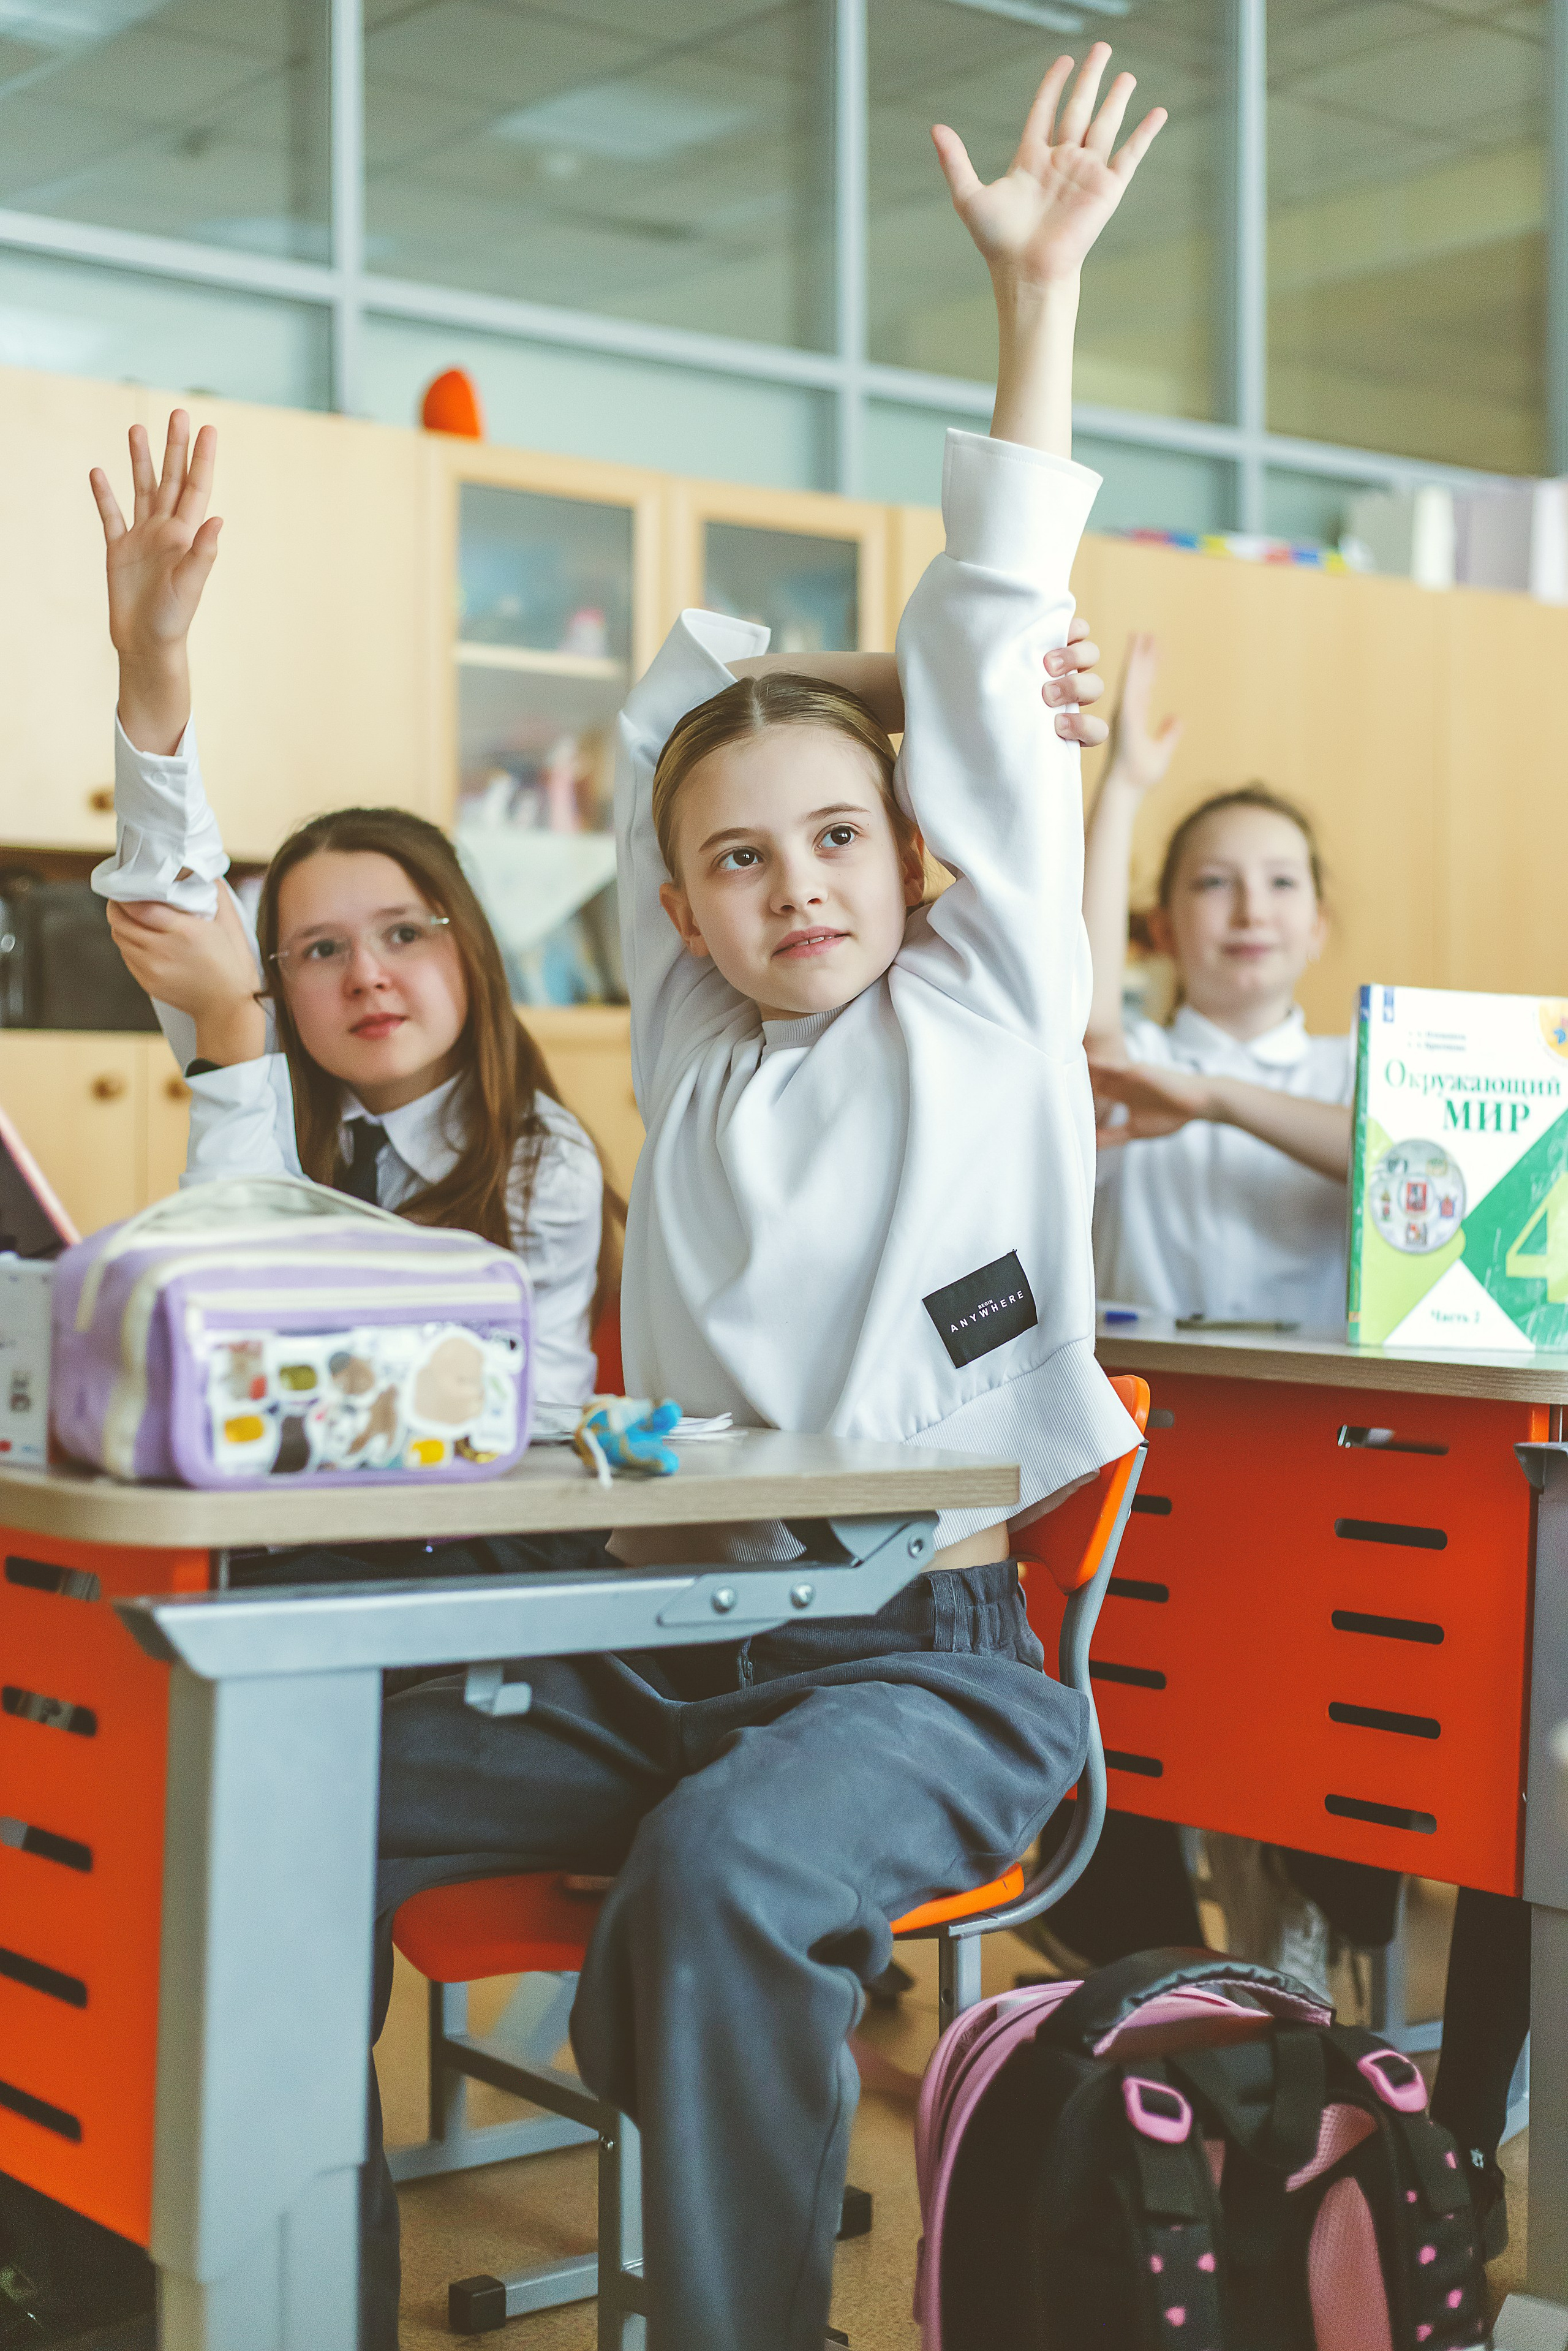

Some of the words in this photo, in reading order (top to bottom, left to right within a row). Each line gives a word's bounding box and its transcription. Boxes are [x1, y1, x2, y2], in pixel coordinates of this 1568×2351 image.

[1385, 1059, 1561, 1097] Окружающий
[1443, 1099, 1531, 1133] МИР
[950, 1290, 1024, 1333] ANYWHERE
[978, 1299, 993, 1309] BEGIN
[1430, 1309, 1470, 1323] Часть
